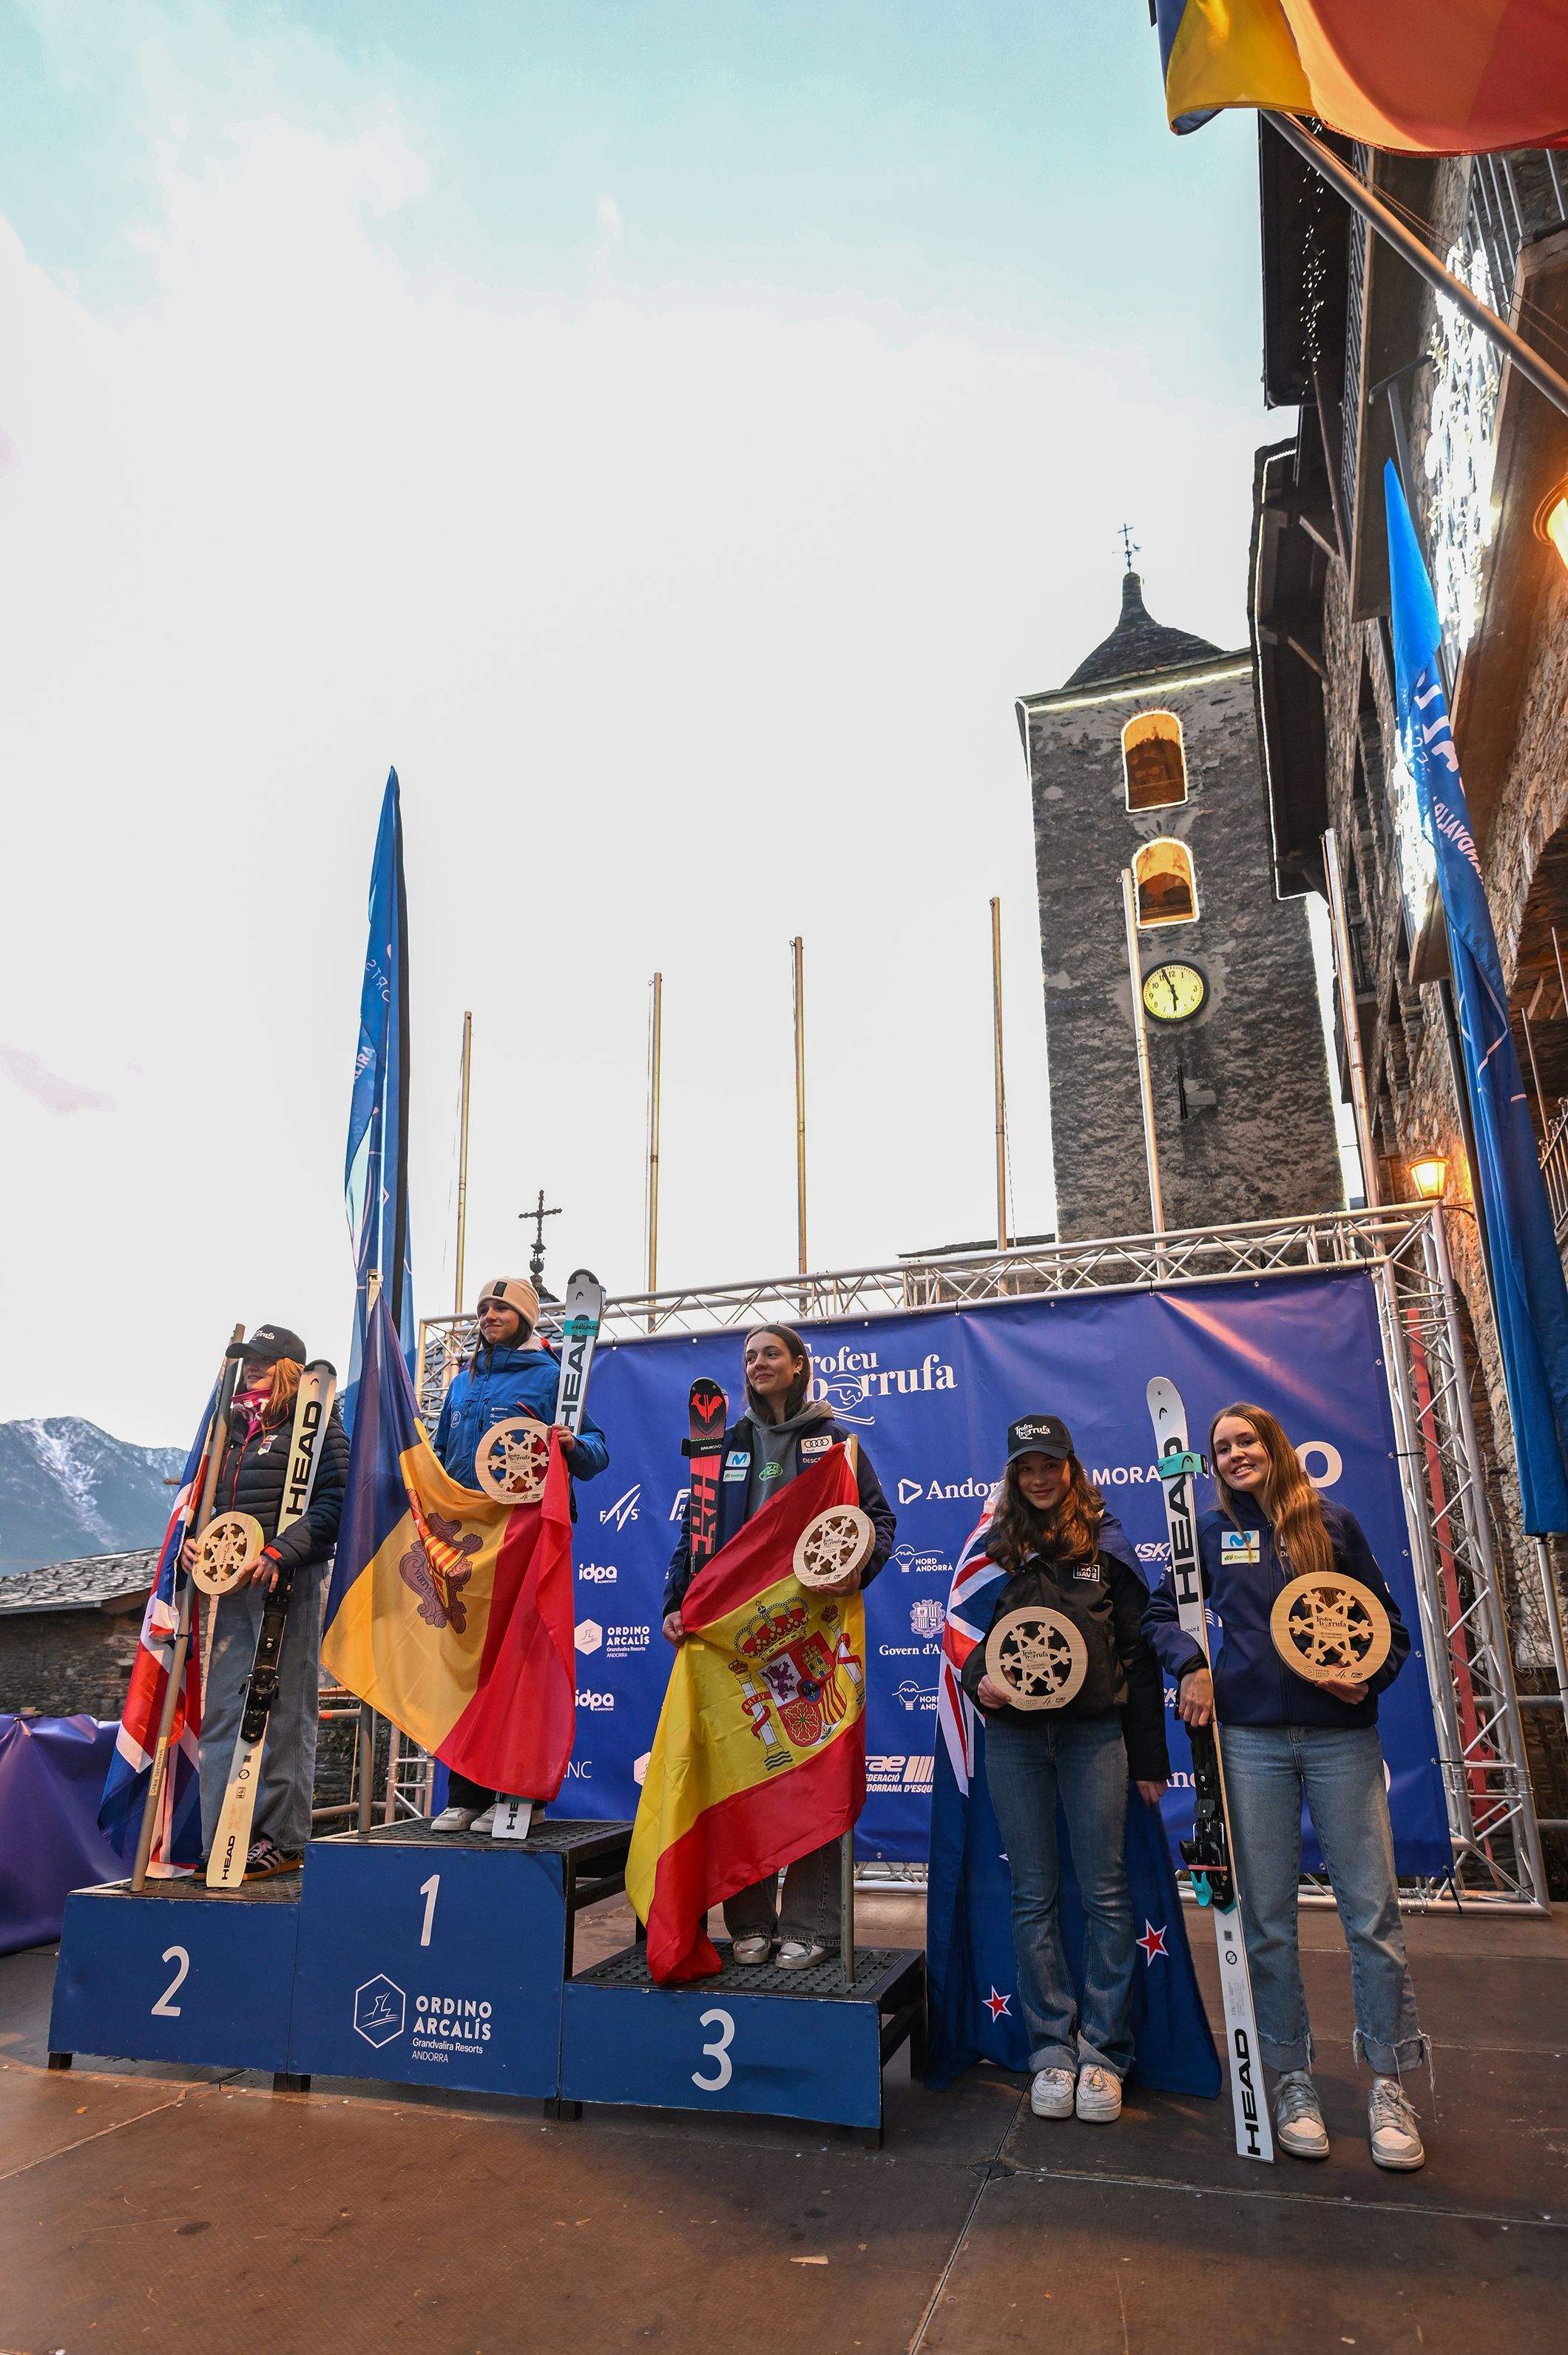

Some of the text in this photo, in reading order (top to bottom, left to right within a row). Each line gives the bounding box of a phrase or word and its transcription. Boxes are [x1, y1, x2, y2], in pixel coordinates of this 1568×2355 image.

[285, 1401, 322, 1516] HEAD
[578, 1563, 618, 1583] idpa
[916, 1563, 953, 1572] ANDORRÀ
[606, 1635, 650, 1646] ARCALÍS
[607, 1626, 650, 1636] ORDINO
[879, 1644, 919, 1656] Govern
[904, 1784, 933, 1794] D'ESQU
[222, 1835, 236, 1880] HEAD
[418, 1873, 441, 1947] 1
[150, 1945, 190, 2017] 2
[416, 1996, 493, 2019] ORDINO
[413, 2016, 492, 2041] ARCALÍS
[412, 2037, 483, 2054] Grandvalira Resorts
[691, 2007, 735, 2092] 3
[411, 2050, 449, 2064] ANDORRA
[1234, 2028, 1261, 2157] HEAD
